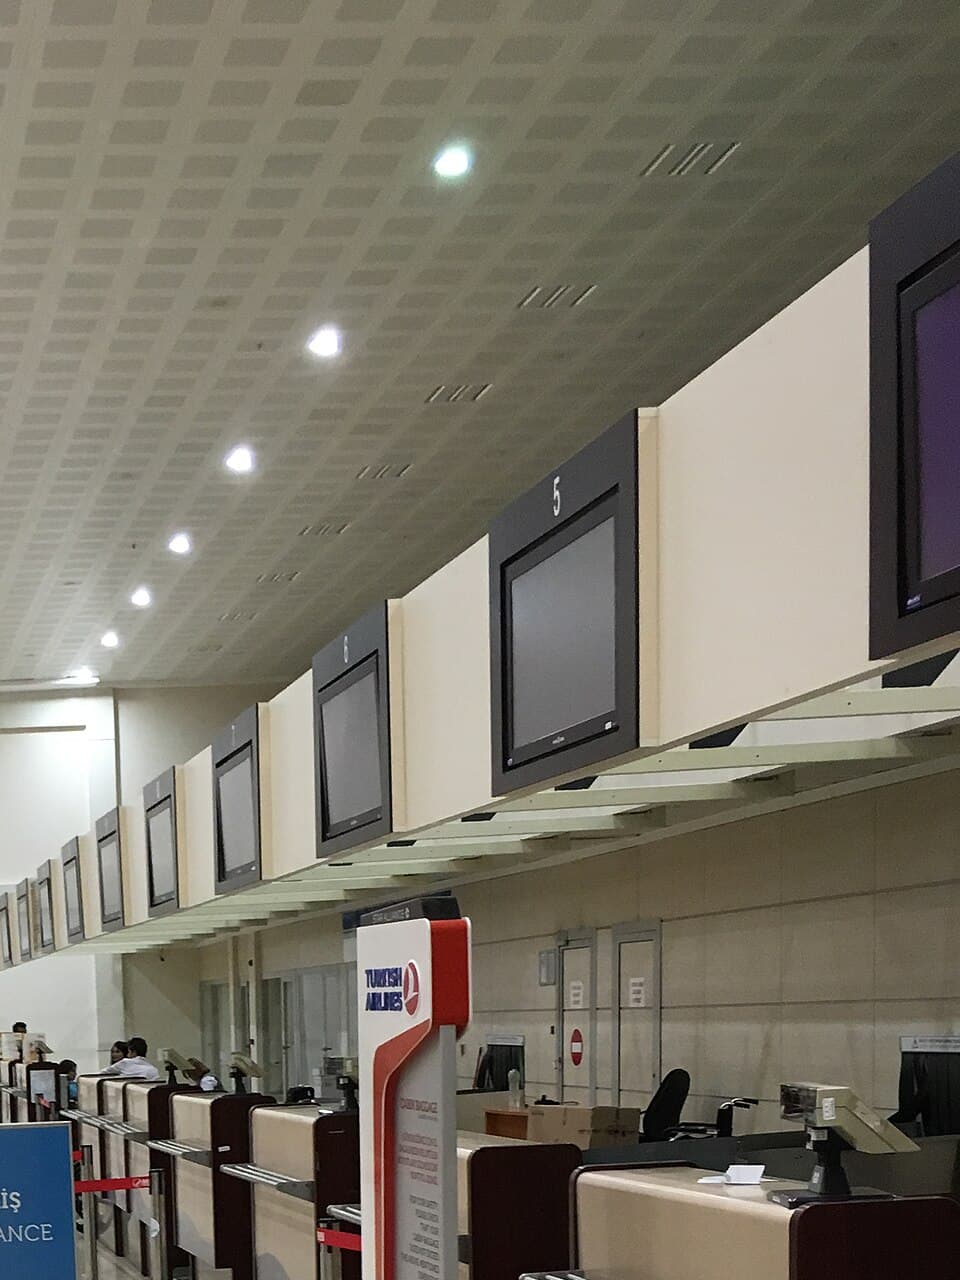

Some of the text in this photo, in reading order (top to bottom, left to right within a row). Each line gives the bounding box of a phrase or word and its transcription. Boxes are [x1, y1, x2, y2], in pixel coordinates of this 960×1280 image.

[553, 476, 561, 516] 5
[365, 967, 402, 988] TURKISH
[365, 992, 403, 1011] AIRLINES
